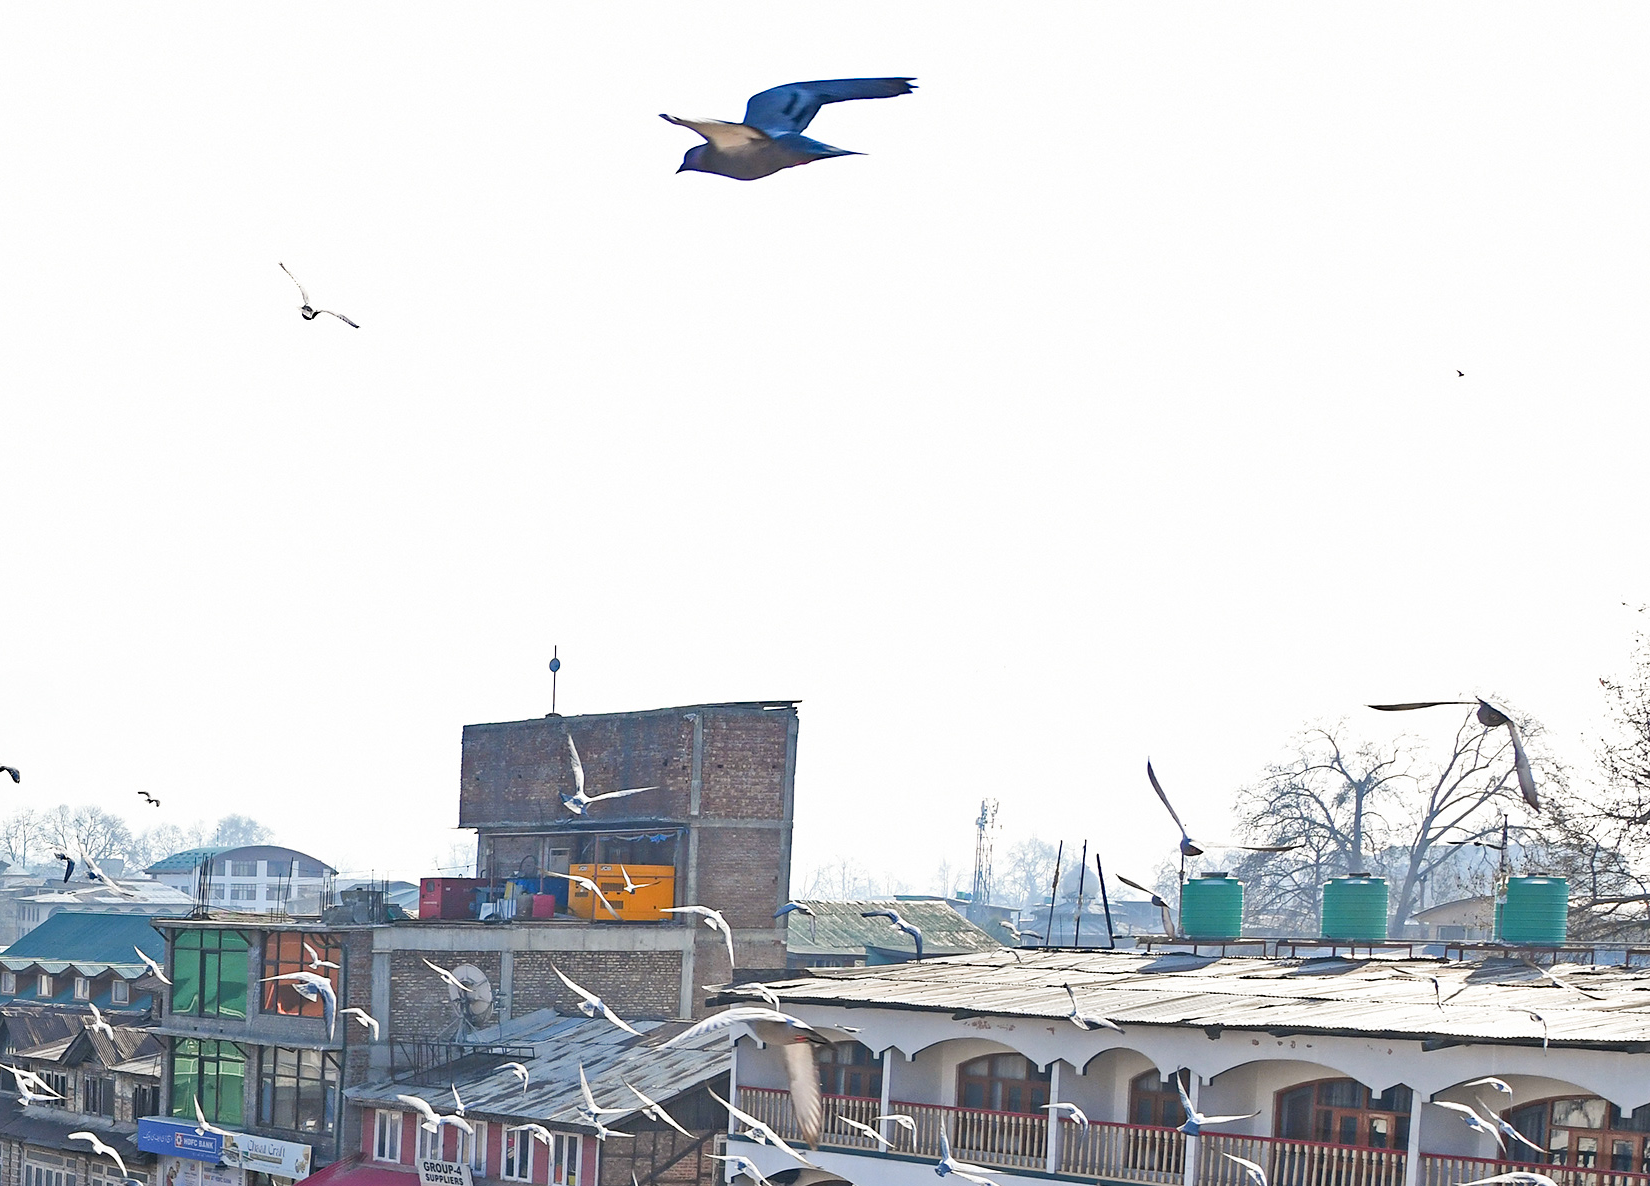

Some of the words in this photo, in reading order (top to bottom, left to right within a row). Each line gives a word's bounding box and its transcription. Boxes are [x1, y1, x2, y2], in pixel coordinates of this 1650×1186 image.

[183, 1137, 198, 1147] HDFC
[198, 1140, 214, 1149] BANK
[423, 1161, 462, 1176] GROUP-4
[425, 1174, 464, 1186] SUPPLIERS
